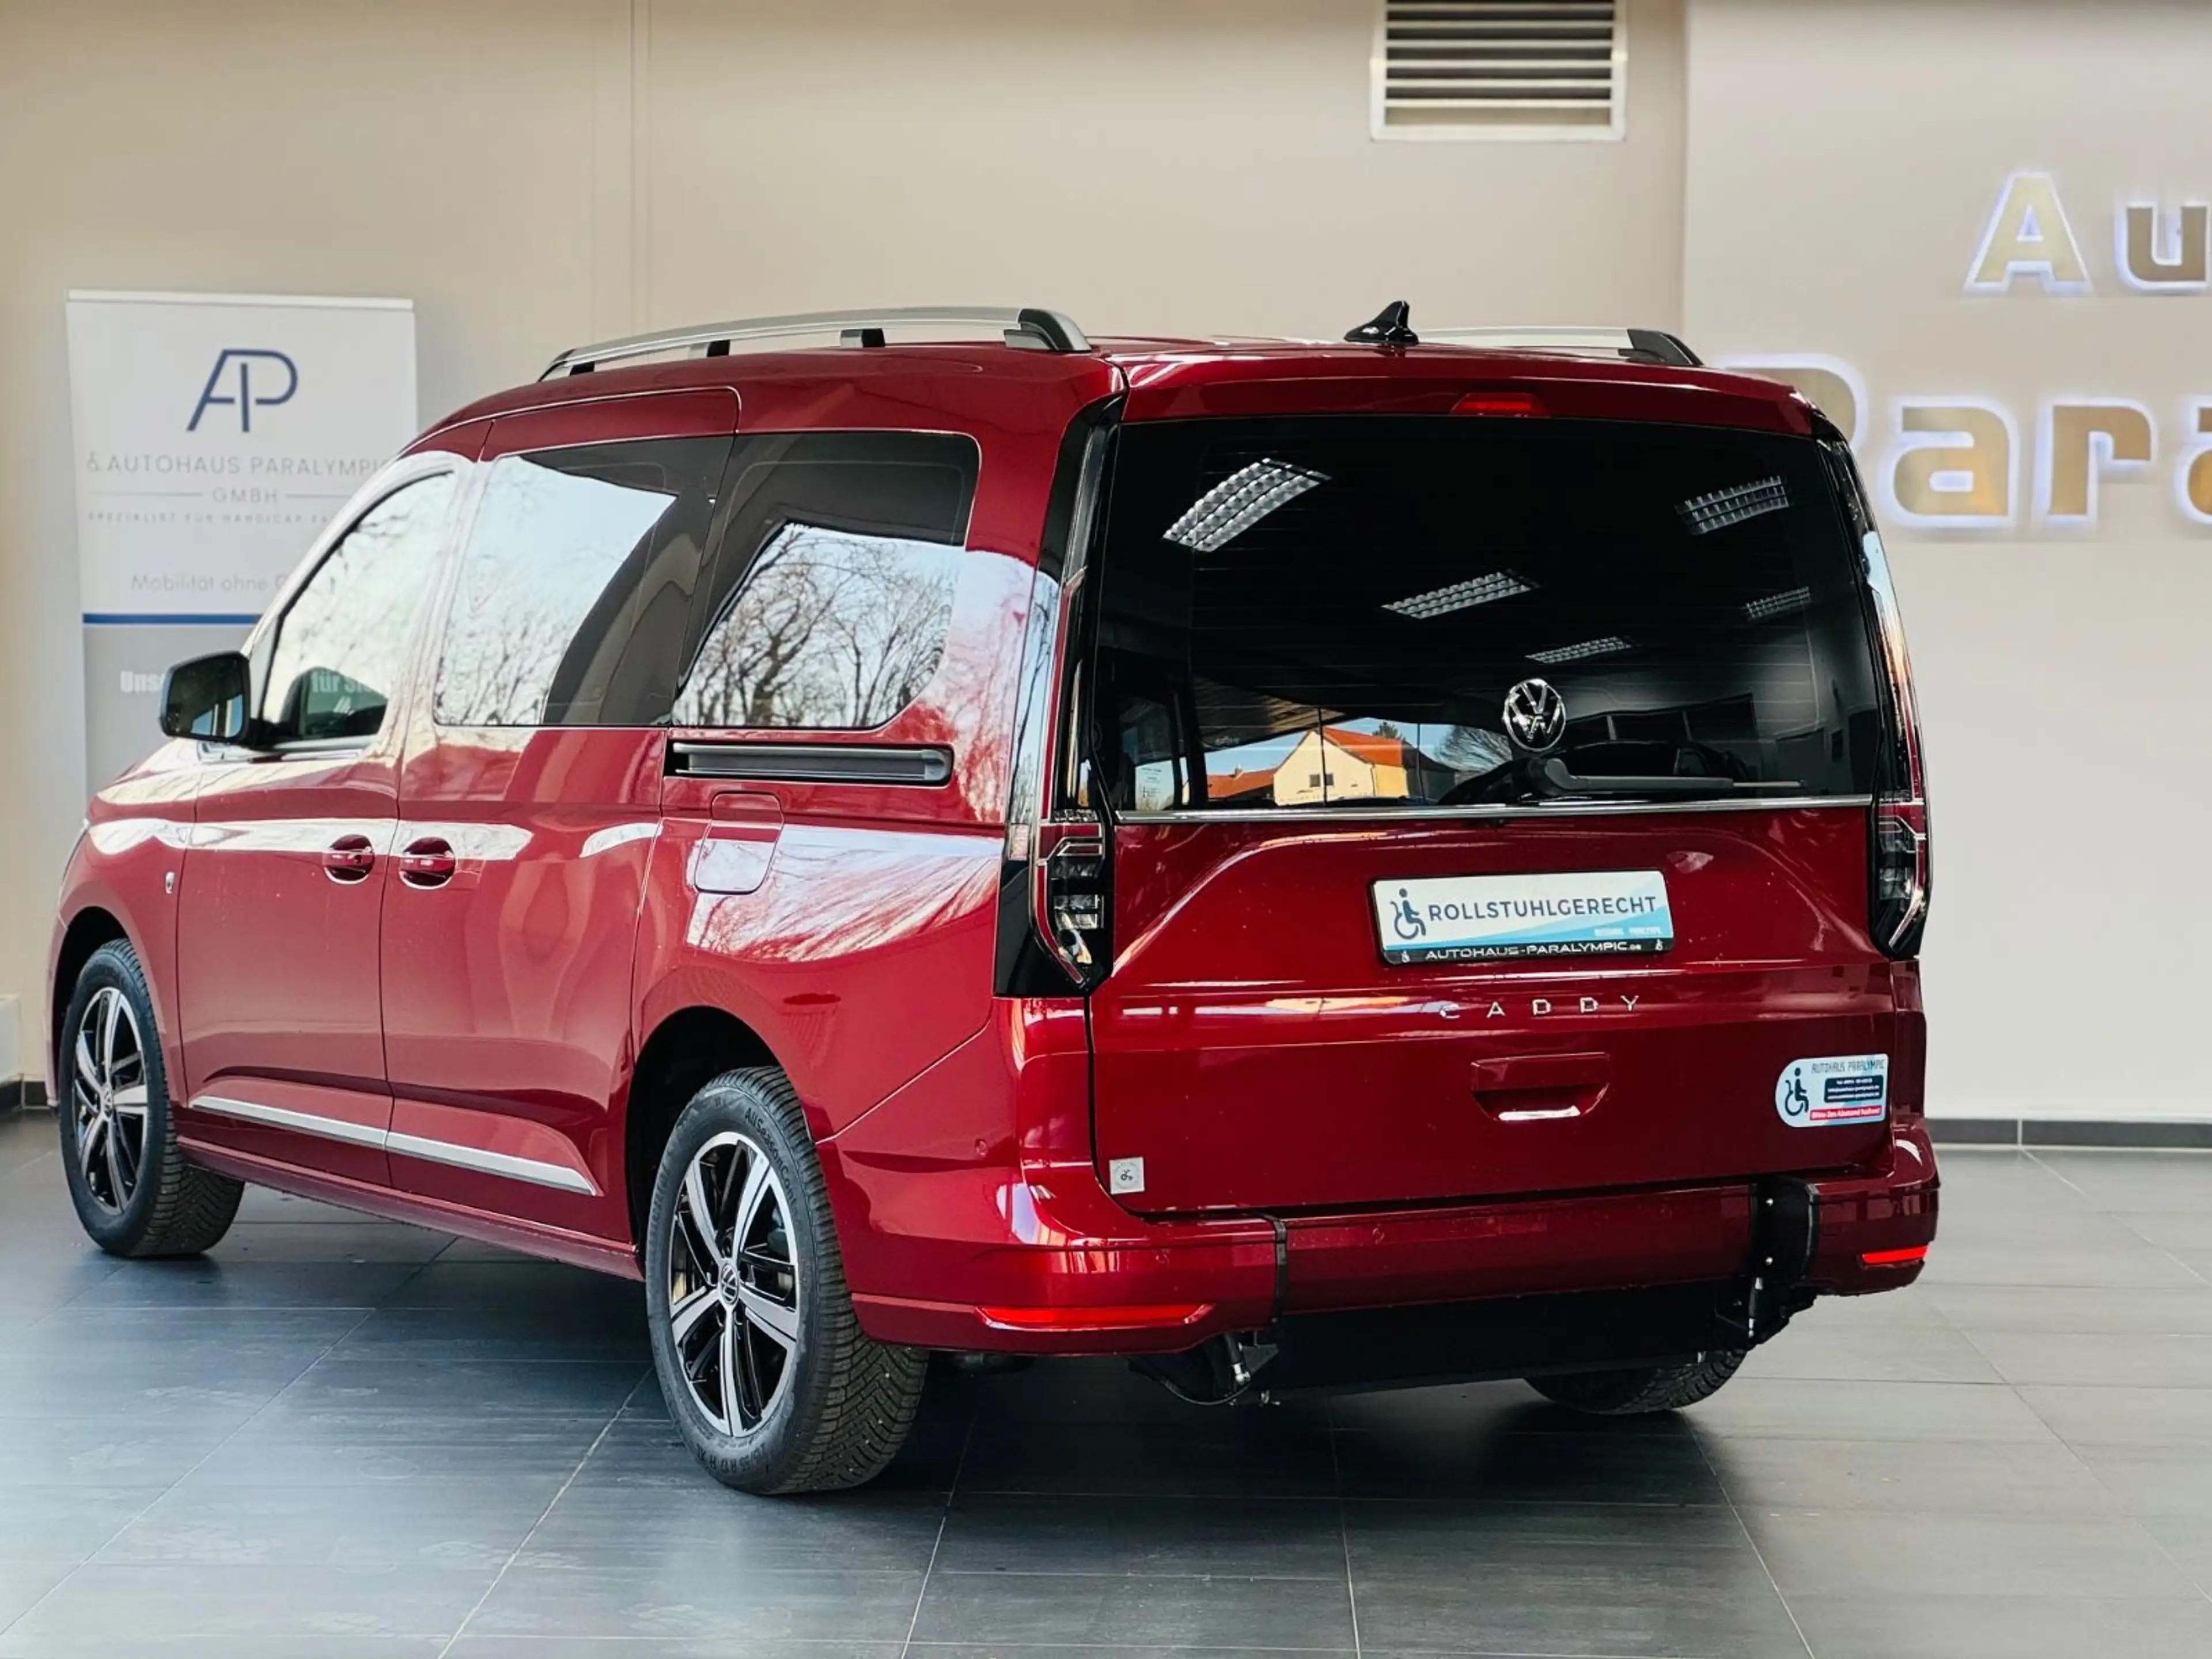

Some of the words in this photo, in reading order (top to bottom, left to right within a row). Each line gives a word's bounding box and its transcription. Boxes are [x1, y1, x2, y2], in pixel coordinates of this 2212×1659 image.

[186, 349, 298, 433] AP
[107, 454, 241, 475] AUTOHAUS
[212, 487, 278, 504] GMBH
[121, 671, 171, 695] Uns
[1427, 895, 1657, 922] ROLLSTUHLGERECHT
[1440, 995, 1639, 1020] CADDY
